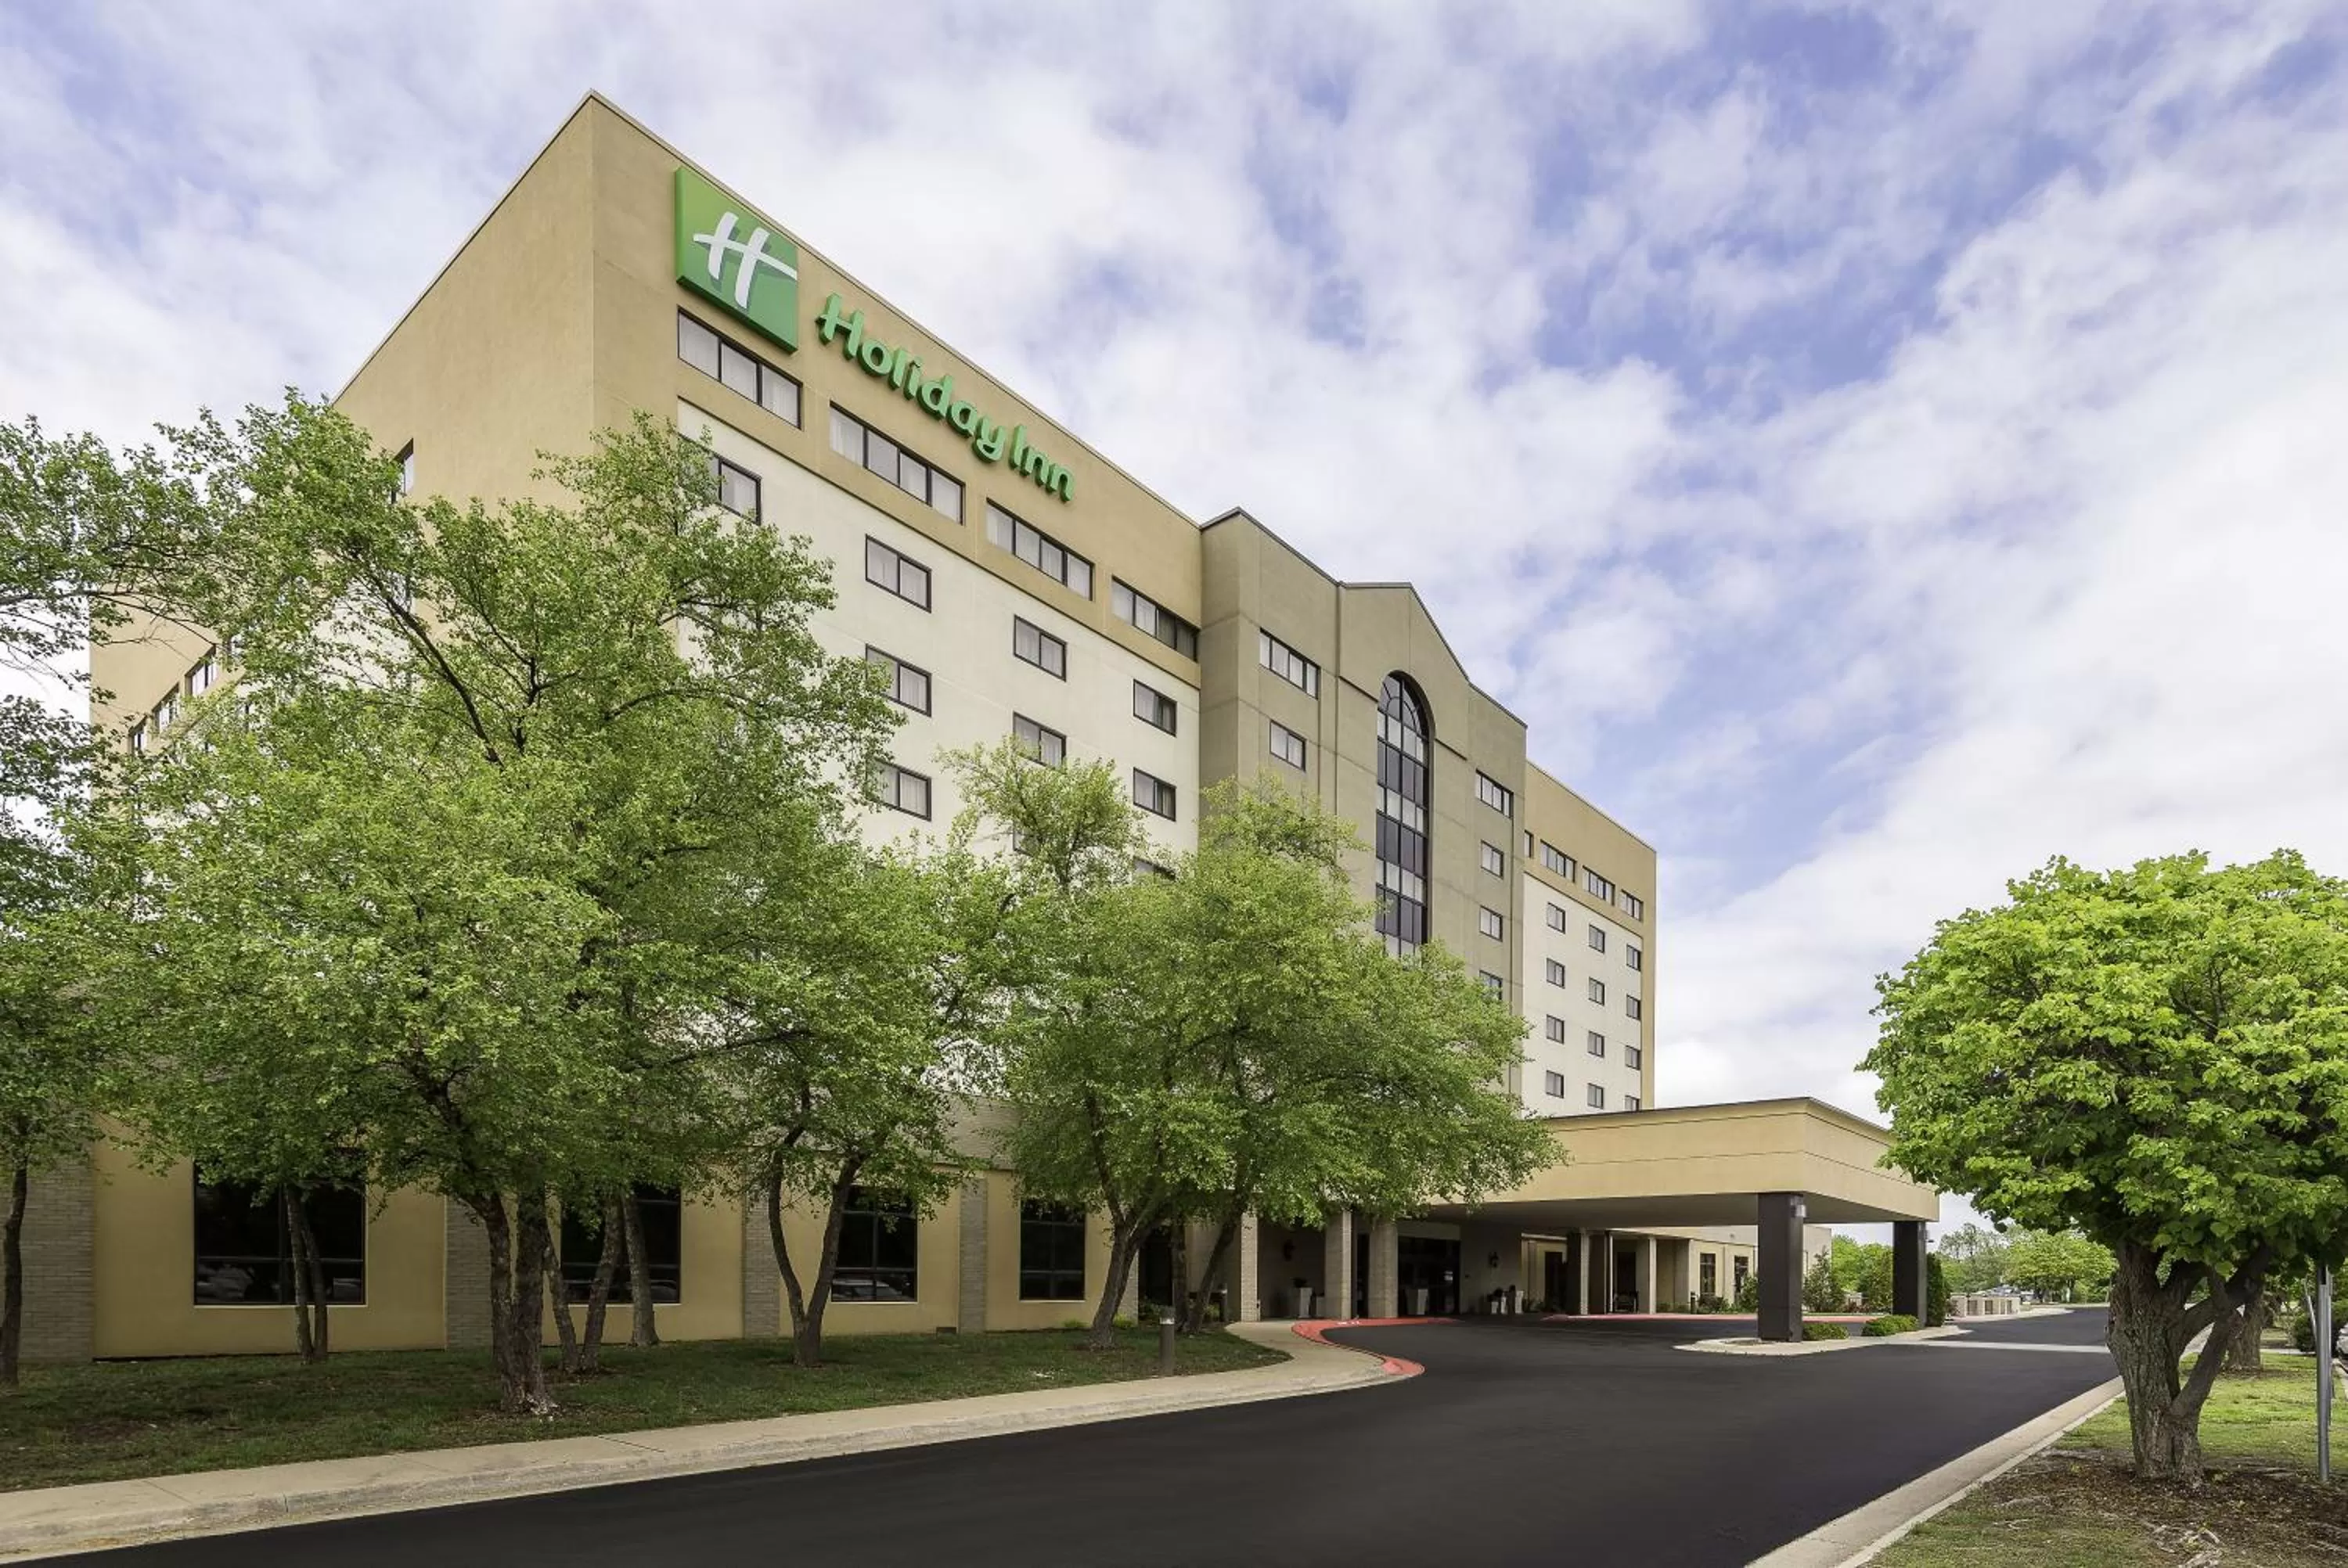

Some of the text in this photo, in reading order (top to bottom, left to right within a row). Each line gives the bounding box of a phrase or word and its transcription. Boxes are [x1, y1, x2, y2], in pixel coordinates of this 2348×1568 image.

[693, 211, 798, 309] H
[816, 293, 1075, 502] Holiday Inn
